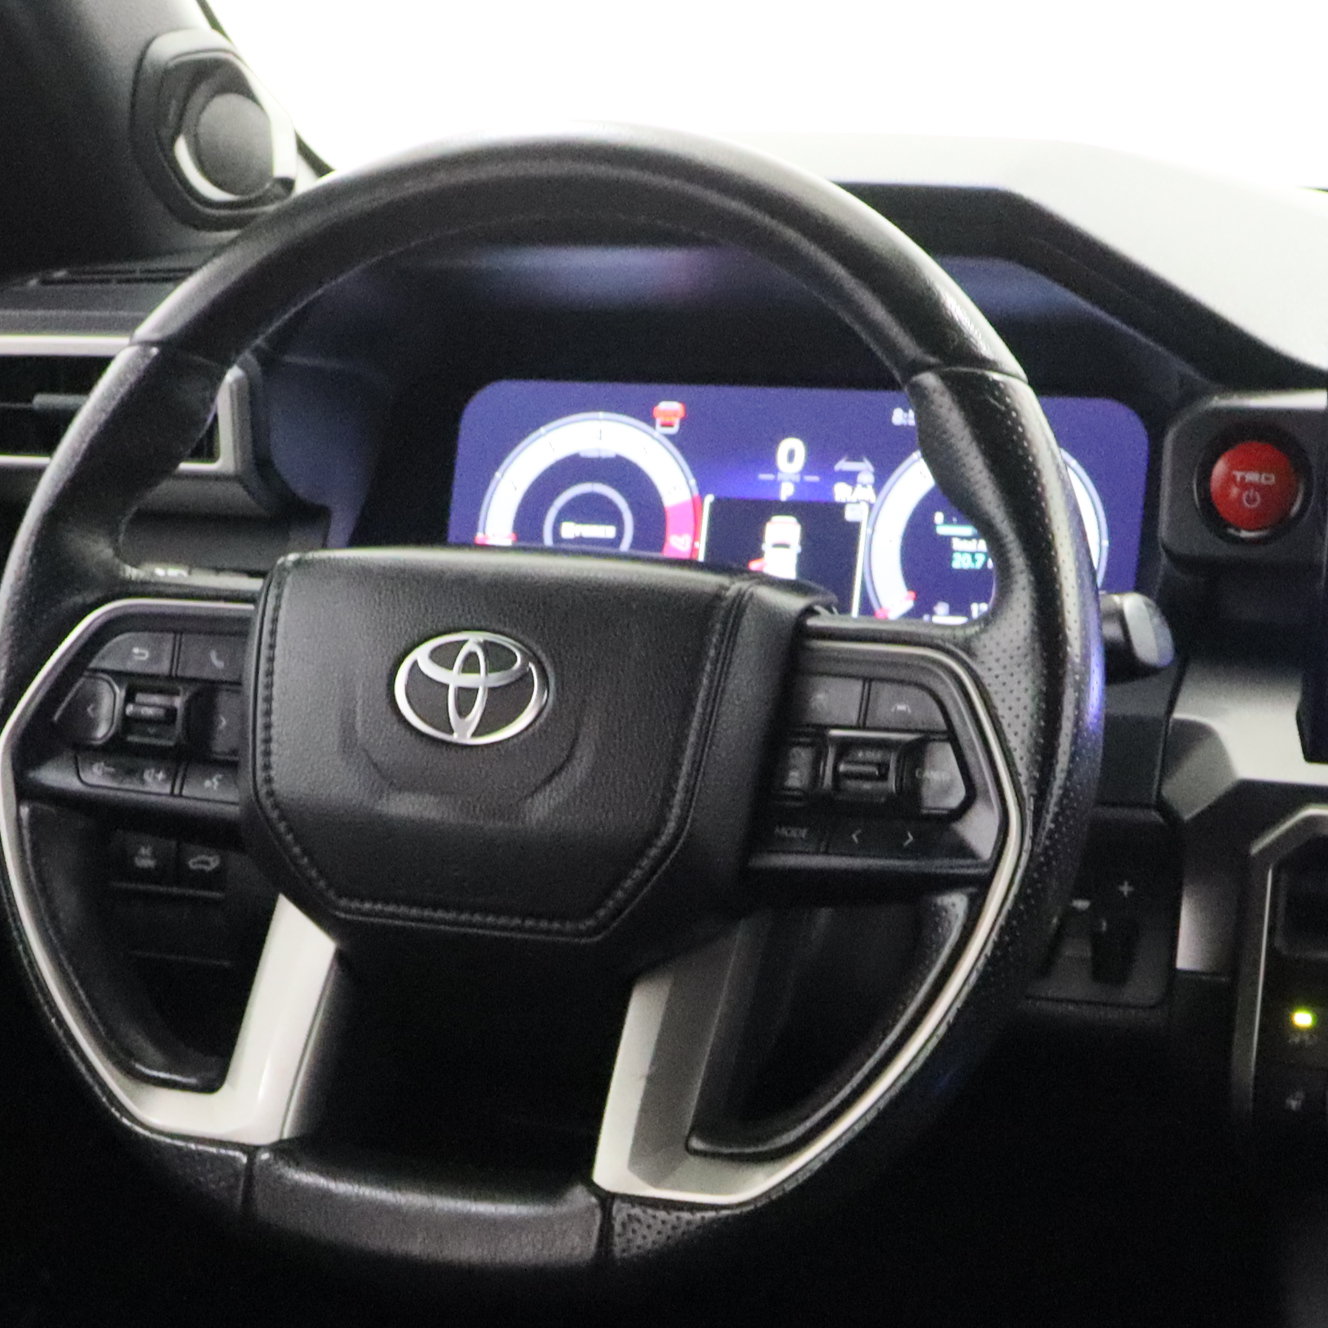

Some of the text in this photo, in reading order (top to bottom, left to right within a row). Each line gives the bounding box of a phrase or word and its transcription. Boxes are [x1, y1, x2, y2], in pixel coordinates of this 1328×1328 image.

[777, 437, 805, 473] 0
[1232, 470, 1276, 485] TRD
[780, 481, 795, 501] P
